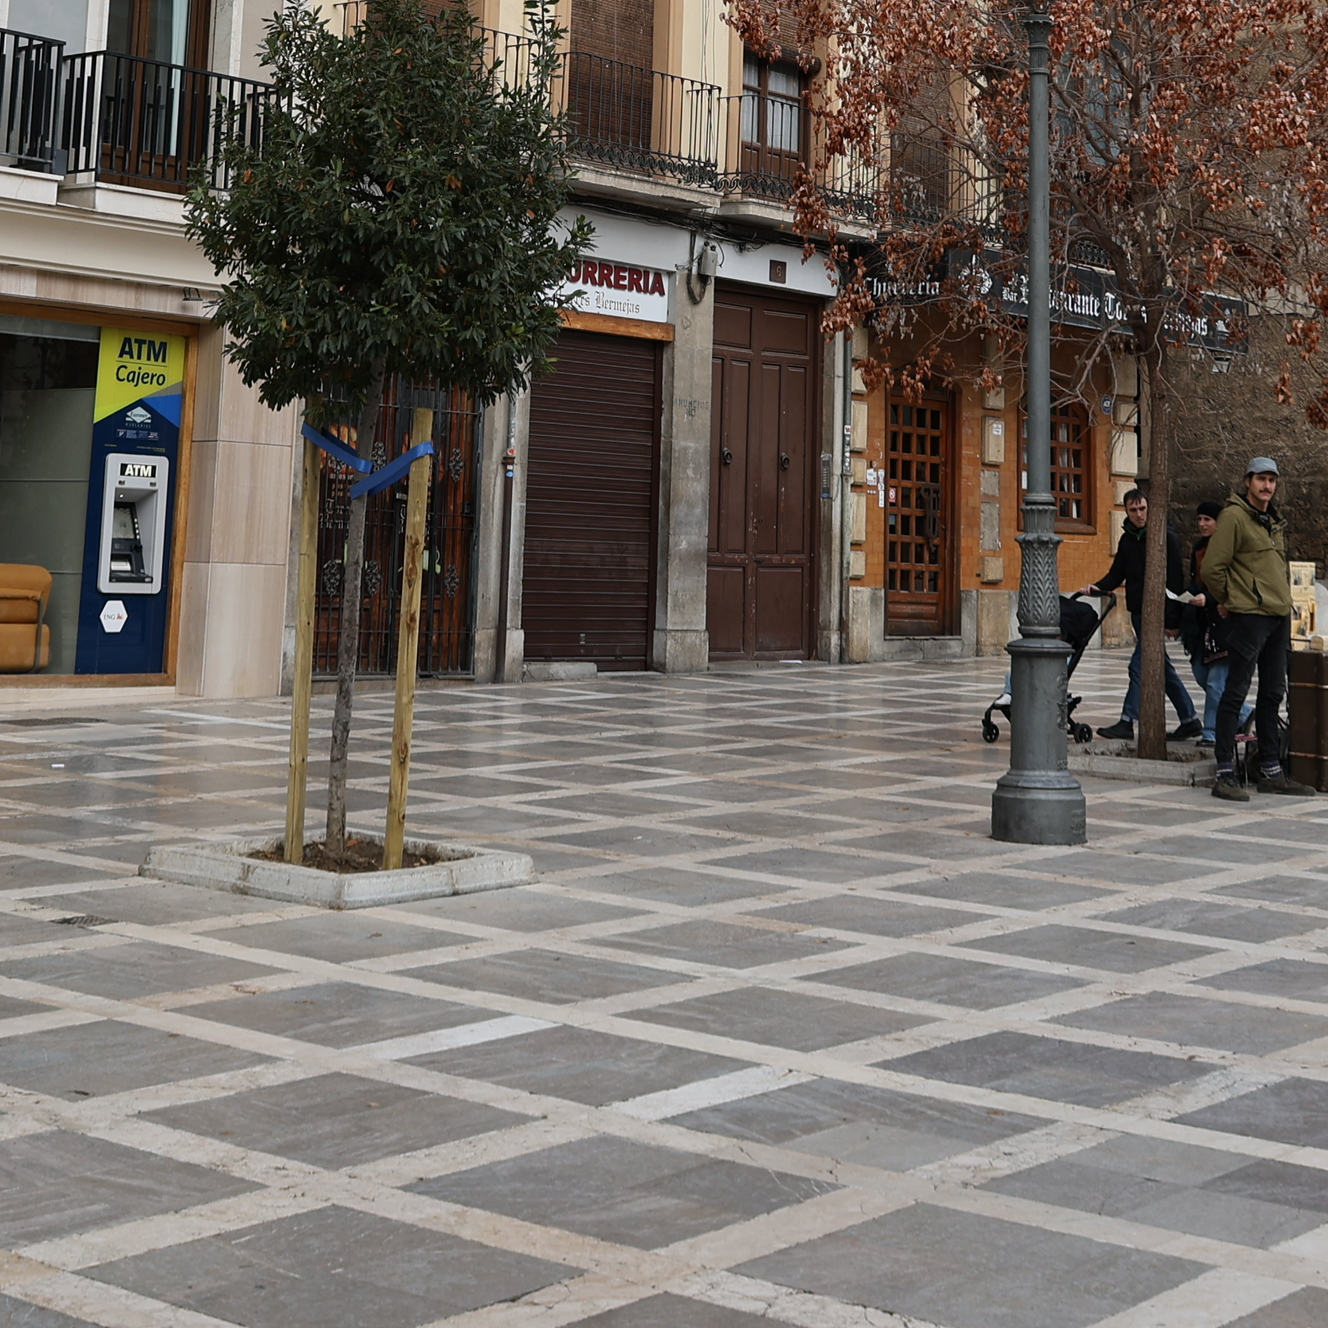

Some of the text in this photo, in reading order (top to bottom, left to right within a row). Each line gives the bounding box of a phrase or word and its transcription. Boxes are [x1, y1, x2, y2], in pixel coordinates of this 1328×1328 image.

[567, 259, 666, 297] URRERIA
[595, 292, 640, 314] Bermejas
[118, 336, 168, 363] ATM
[115, 364, 166, 388] Cajero
[124, 464, 152, 477] ATM
